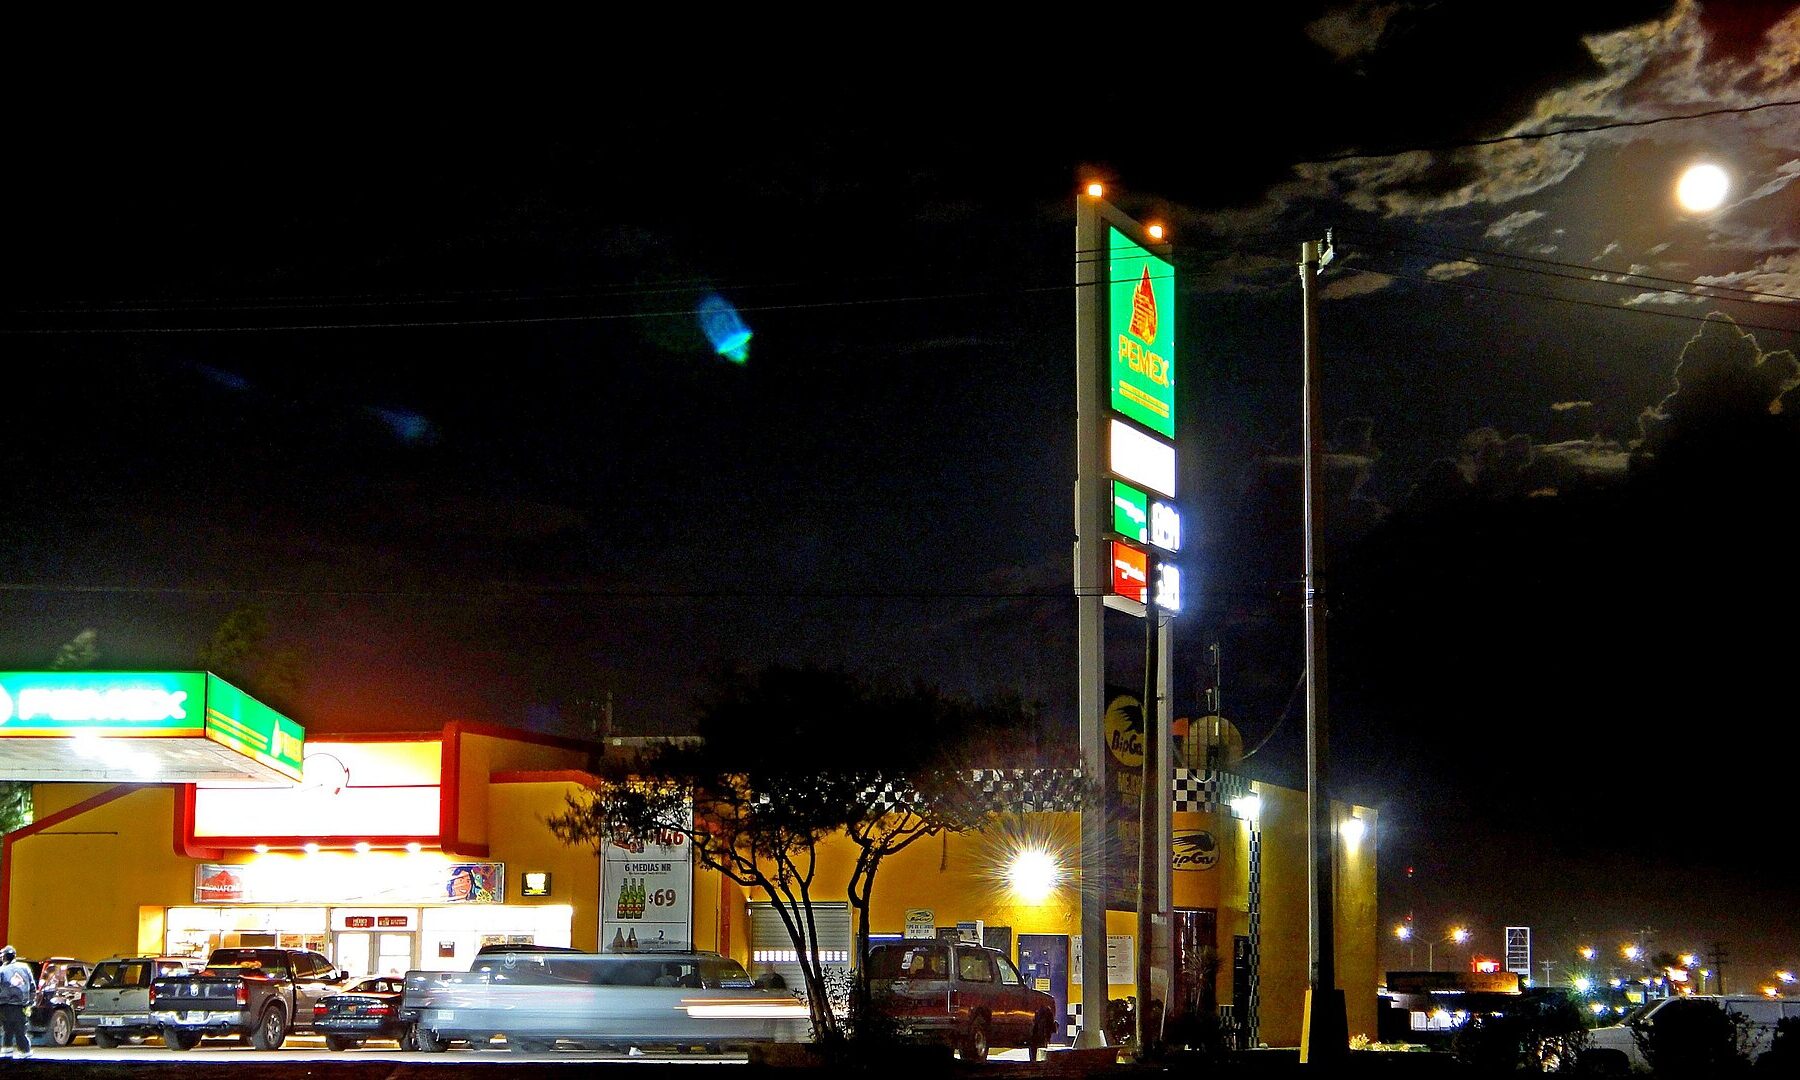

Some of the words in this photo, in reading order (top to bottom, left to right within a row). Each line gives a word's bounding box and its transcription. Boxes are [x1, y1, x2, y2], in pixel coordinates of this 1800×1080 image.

[1119, 334, 1169, 388] PEMEX
[624, 863, 630, 872] 6
[632, 863, 659, 872] MEDIAS
[648, 888, 677, 907] $69
[658, 930, 665, 941] 2
